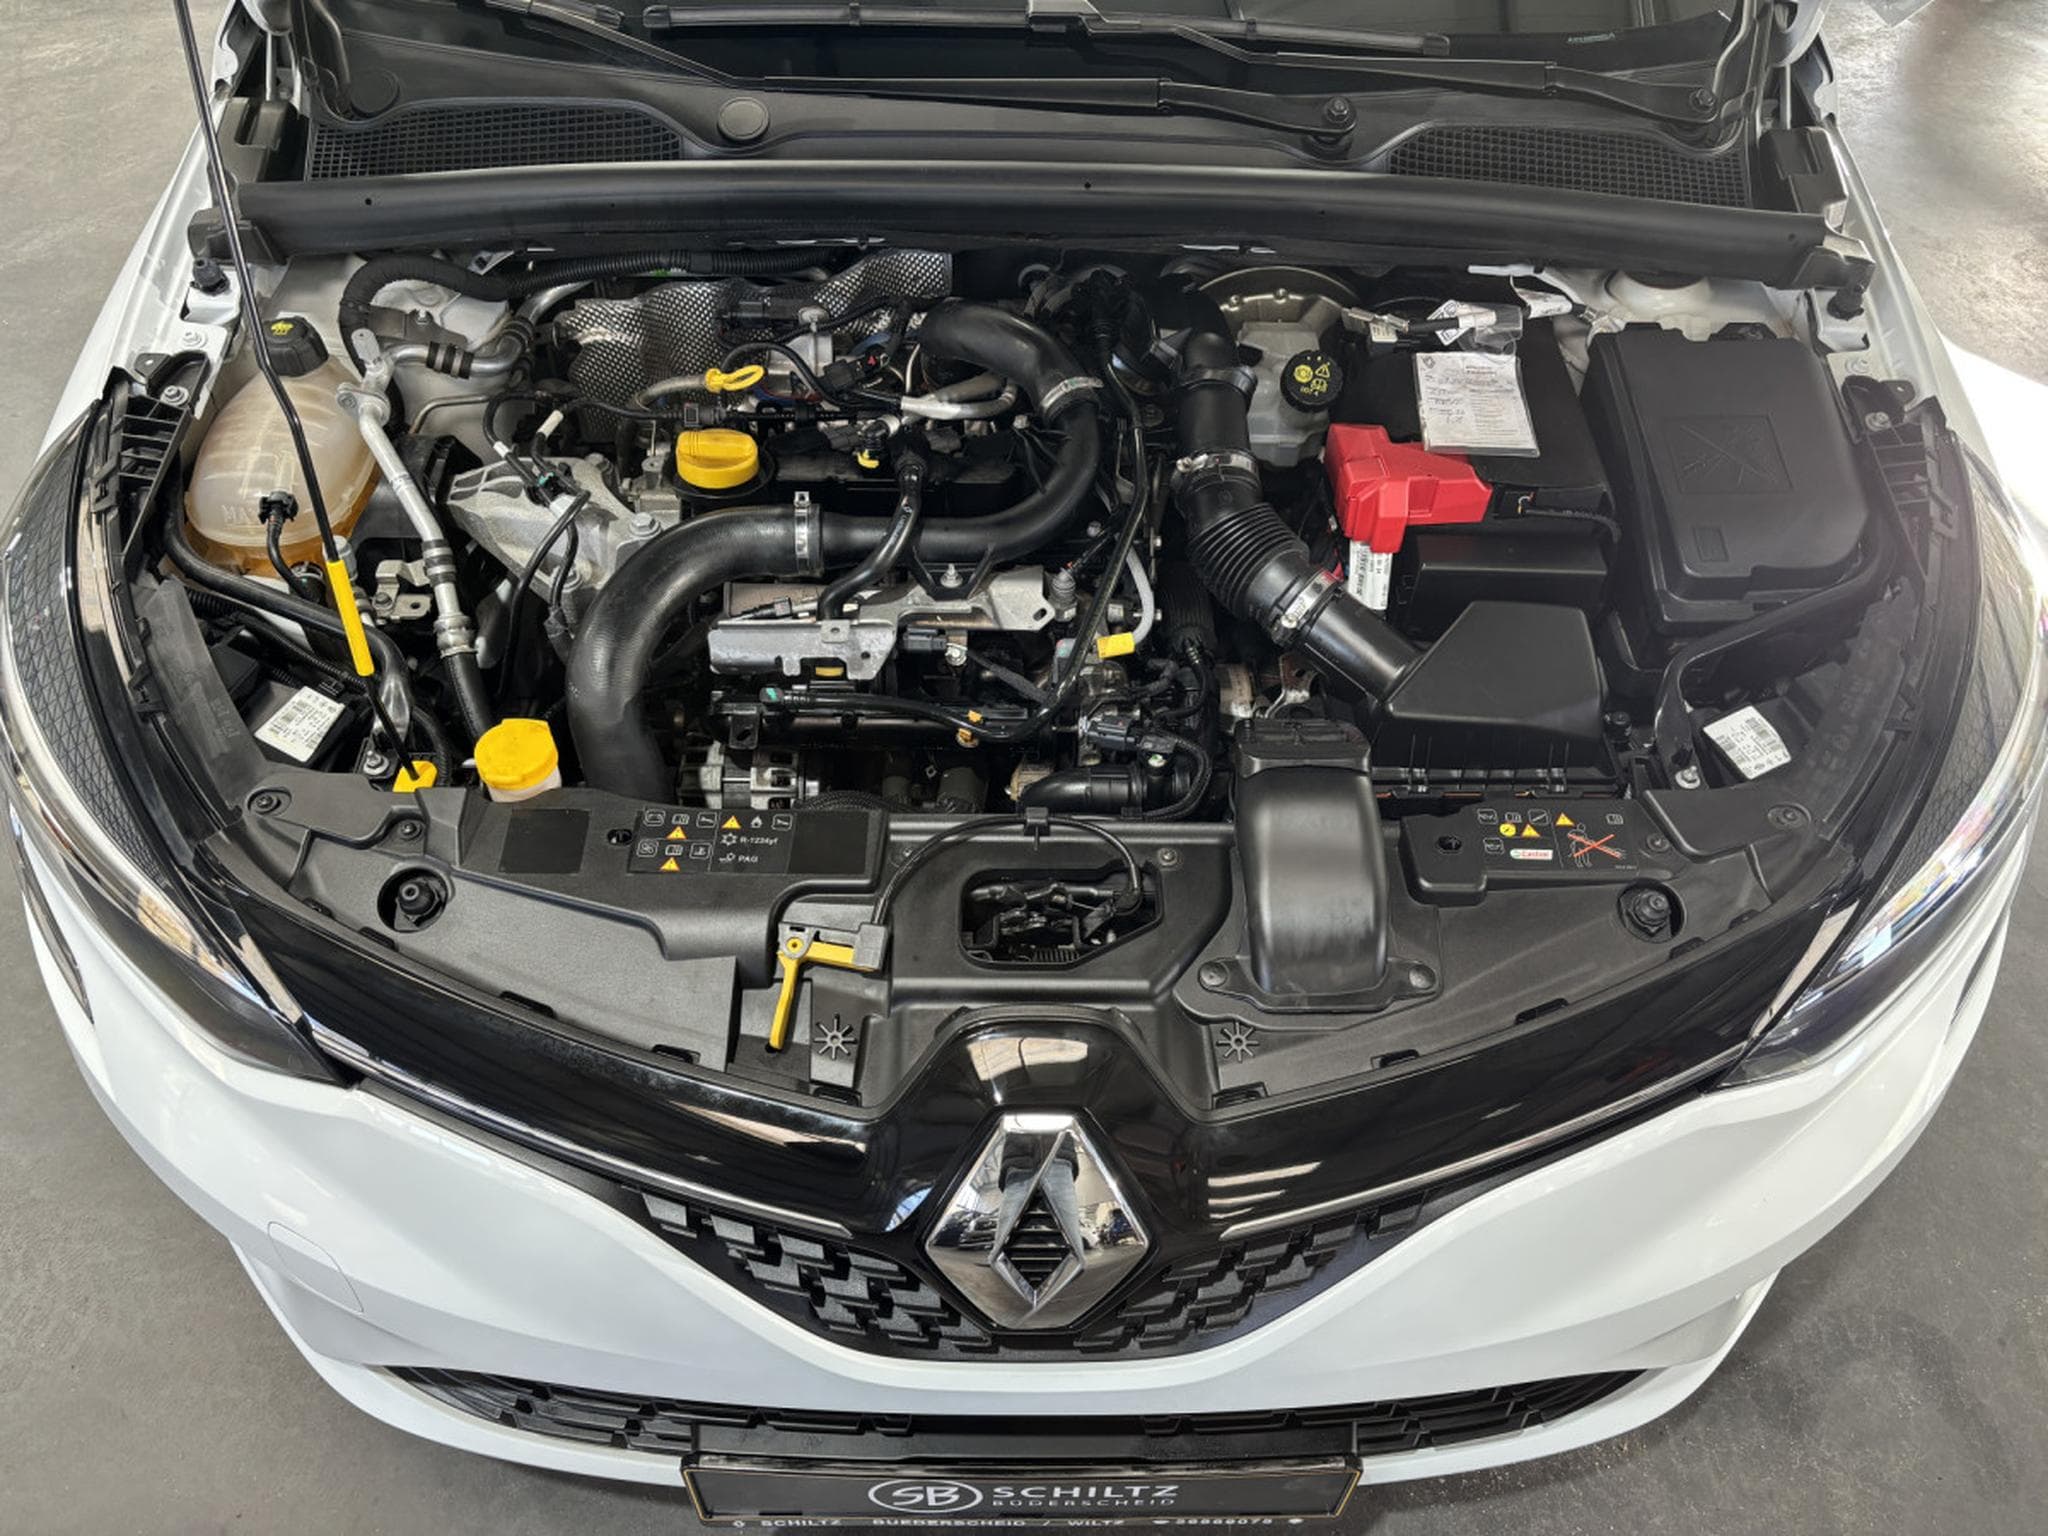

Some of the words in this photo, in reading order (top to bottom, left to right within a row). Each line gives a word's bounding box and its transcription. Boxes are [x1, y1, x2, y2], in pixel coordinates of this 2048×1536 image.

[892, 1486, 960, 1506] SB
[993, 1485, 1180, 1498] SCHILTZ
[761, 1519, 842, 1527] SCHILTZ
